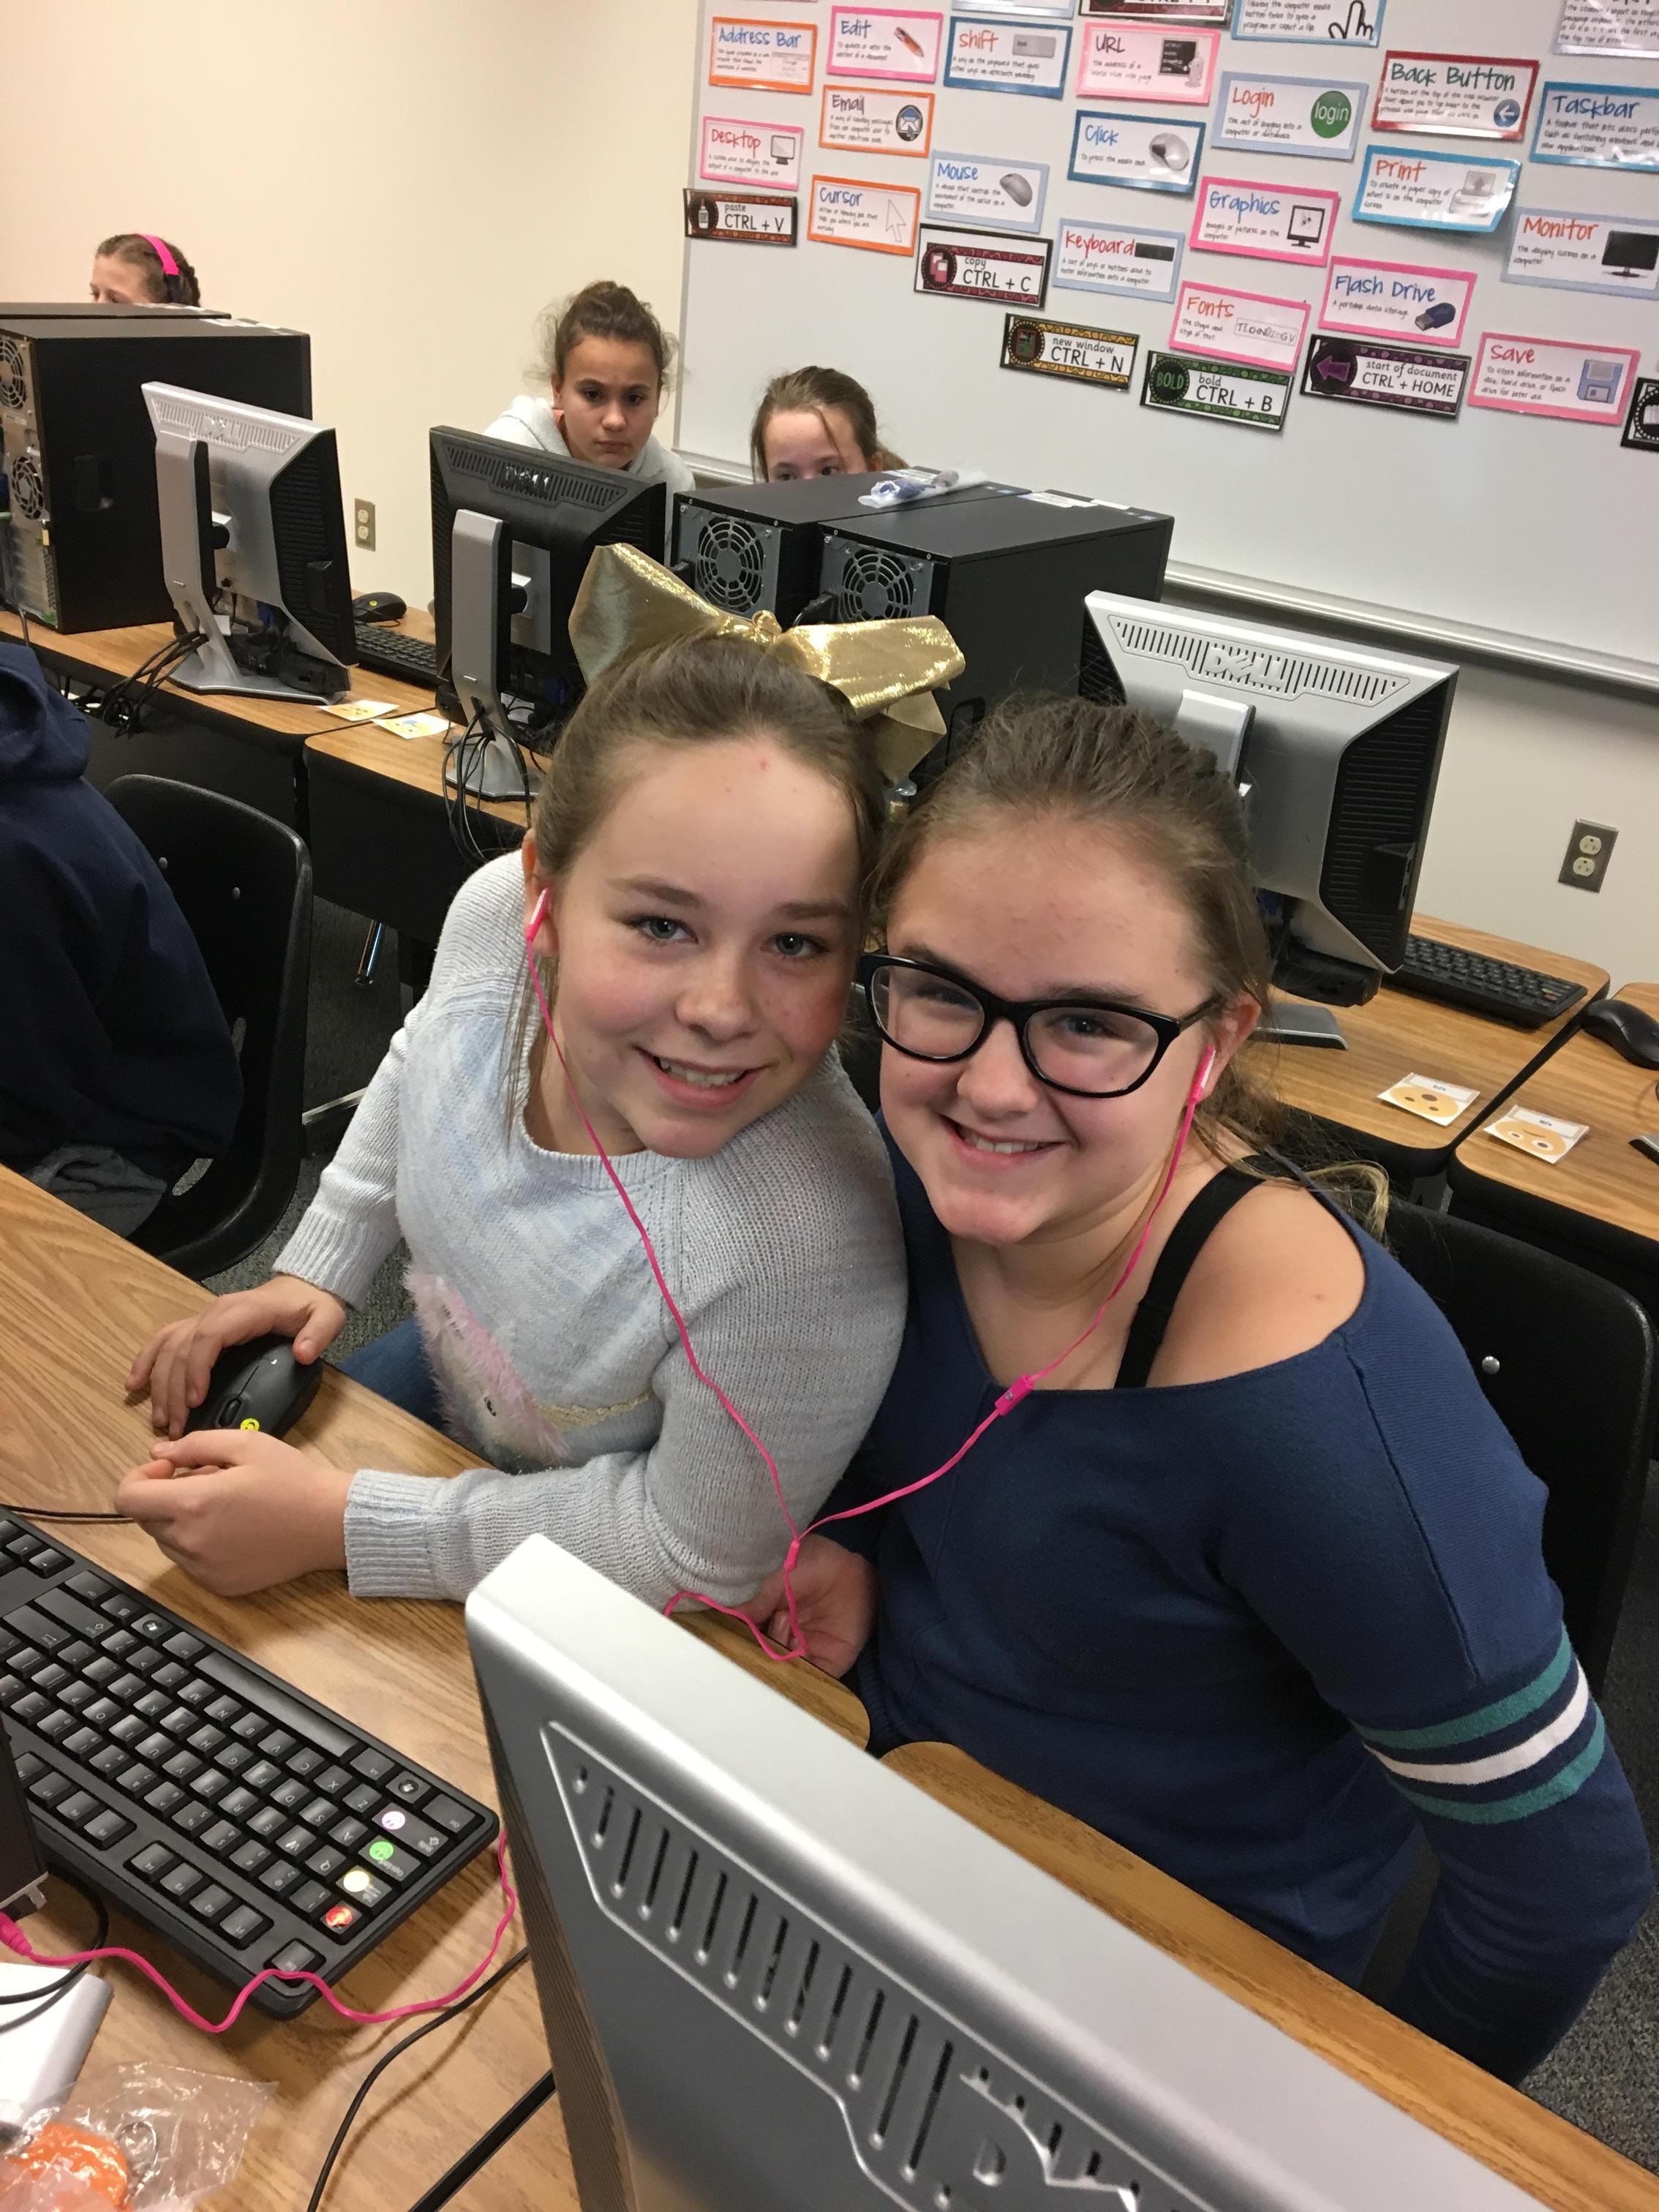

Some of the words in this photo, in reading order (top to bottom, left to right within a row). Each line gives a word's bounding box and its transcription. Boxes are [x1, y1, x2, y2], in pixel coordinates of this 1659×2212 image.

[719, 27, 770, 45] Address
[776, 31, 801, 48] Bar
[841, 19, 871, 39] Edit
[1096, 34, 1125, 53] URL
[1391, 63, 1437, 87] Back
[1446, 65, 1516, 91] Button
[832, 94, 865, 115] Email
[1233, 86, 1275, 118] Login
[1314, 101, 1349, 124] login
[1553, 95, 1639, 119] Taskbar
[712, 129, 761, 158] Desktop
[1086, 124, 1119, 146] Click
[938, 163, 978, 180] Mouse
[1376, 159, 1426, 182] Print
[820, 187, 862, 206] Cursor
[1210, 191, 1279, 224] Graphics
[725, 203, 746, 213] paste
[725, 214, 757, 230] CTRL
[762, 220, 770, 231] +
[774, 217, 784, 232] V
[1523, 217, 1598, 241] Monitor
[1066, 230, 1135, 258] Keyboard
[965, 257, 986, 270] copy
[963, 269, 999, 288] CTRL
[1006, 278, 1015, 289] +
[1020, 276, 1031, 292] C
[1335, 276, 1383, 296] Flash
[1391, 281, 1435, 302] Drive
[1187, 297, 1235, 318] Fonts
[1053, 336, 1072, 347] new
[1077, 339, 1114, 354] window
[1491, 345, 1535, 364] Save
[1051, 347, 1089, 366] CTRL
[1095, 358, 1105, 369] +
[1111, 356, 1124, 372] N
[1366, 360, 1390, 371] start
[1393, 364, 1406, 378] of
[1407, 366, 1457, 381] document
[1156, 372, 1184, 389] BOLD
[1199, 373, 1221, 387] bold
[1362, 372, 1393, 388] CTRL
[1400, 380, 1407, 390] +
[1412, 380, 1455, 397] HOME
[1196, 385, 1237, 407] CTRL
[1245, 397, 1254, 409] +
[1261, 395, 1273, 412] B
[1205, 646, 1282, 688] DELL
